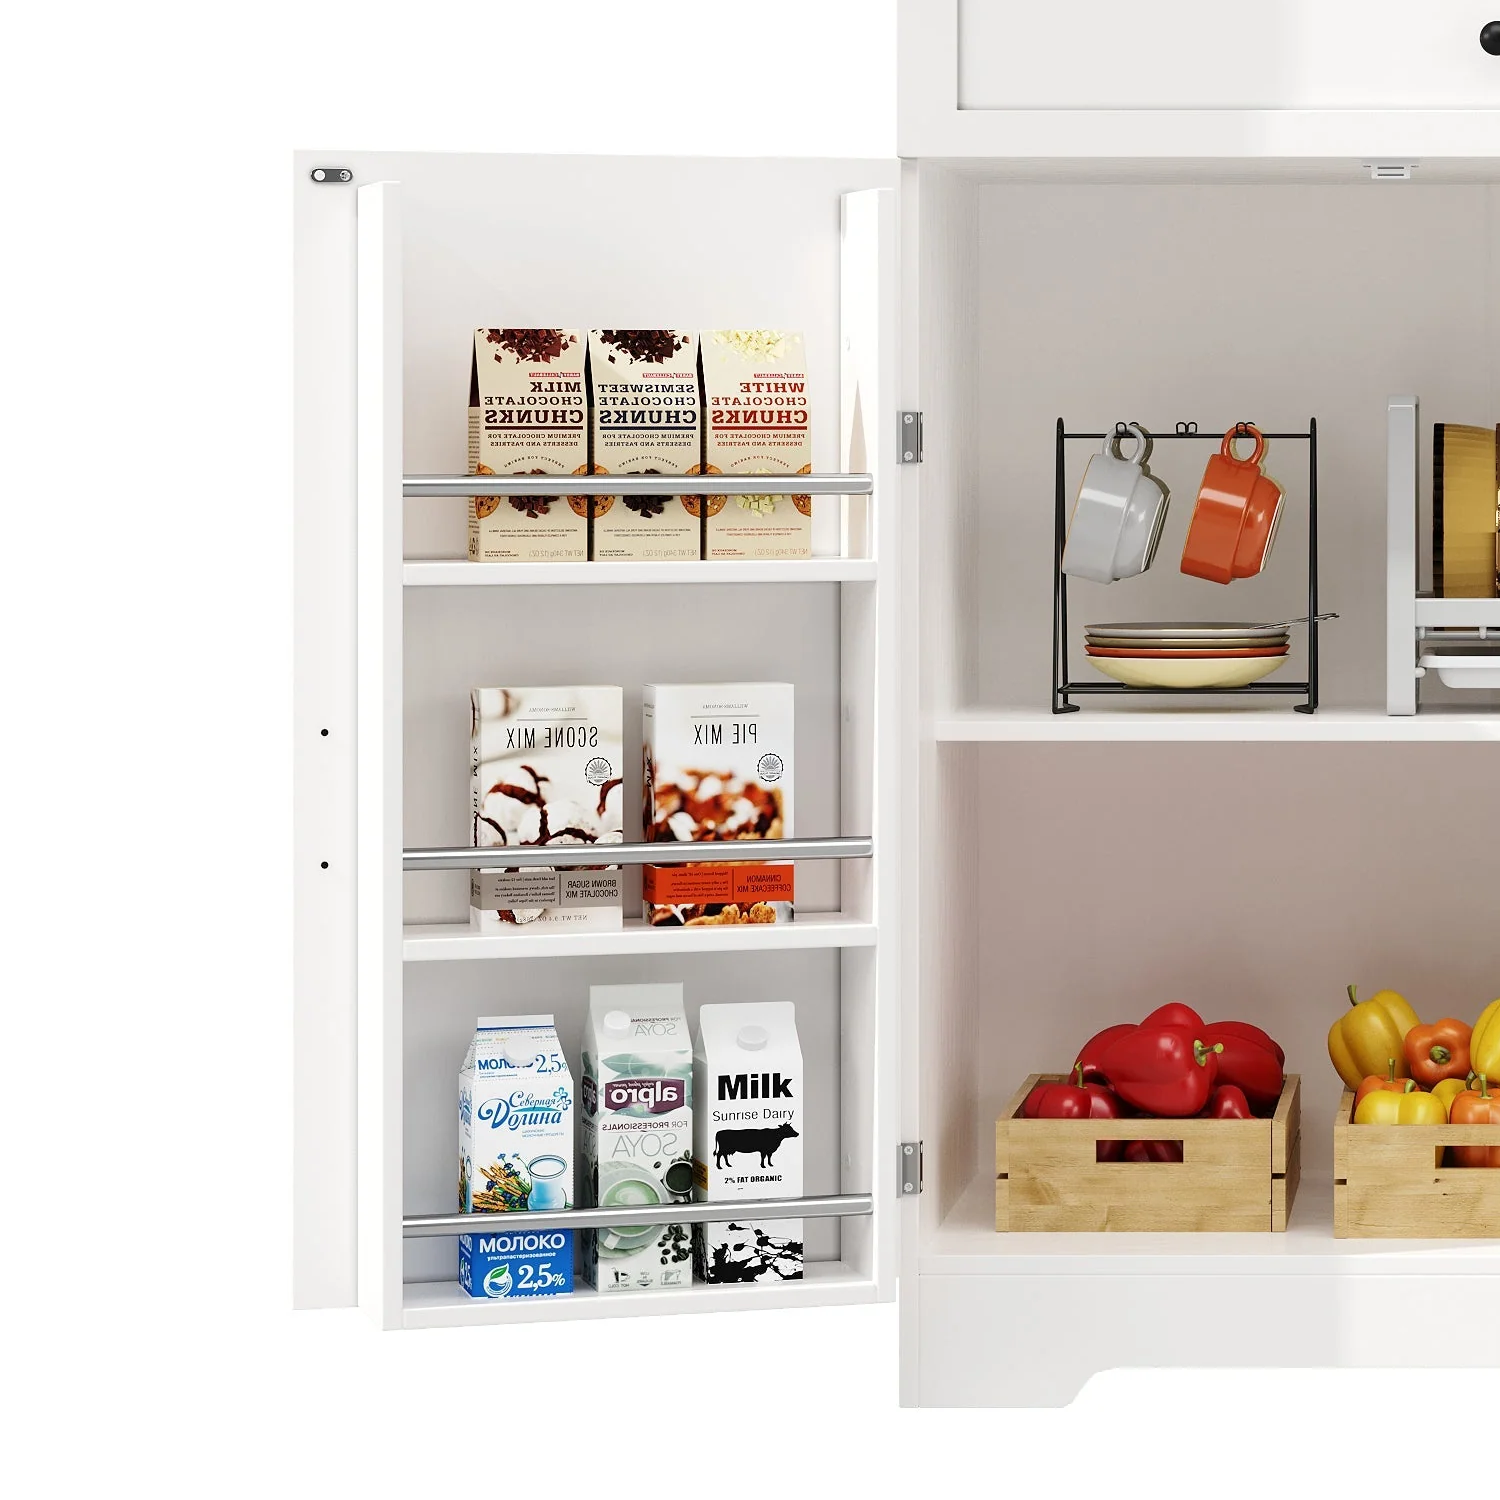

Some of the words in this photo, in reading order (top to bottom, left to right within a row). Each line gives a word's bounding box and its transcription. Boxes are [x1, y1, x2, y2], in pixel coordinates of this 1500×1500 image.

[477, 1058, 534, 1071] МОЛ
[717, 1072, 794, 1101] Milk
[509, 1090, 556, 1110] Северная
[477, 1098, 562, 1131] Долина
[712, 1109, 759, 1122] Sunrise
[762, 1108, 795, 1121] Dairy
[724, 1176, 736, 1184] 2%
[736, 1176, 749, 1184] FAT
[750, 1174, 783, 1183] ORGANIC
[479, 1233, 566, 1254] МОЛОКО
[487, 1252, 556, 1261] ультрапастеризованное
[517, 1263, 566, 1292] 2,5%
